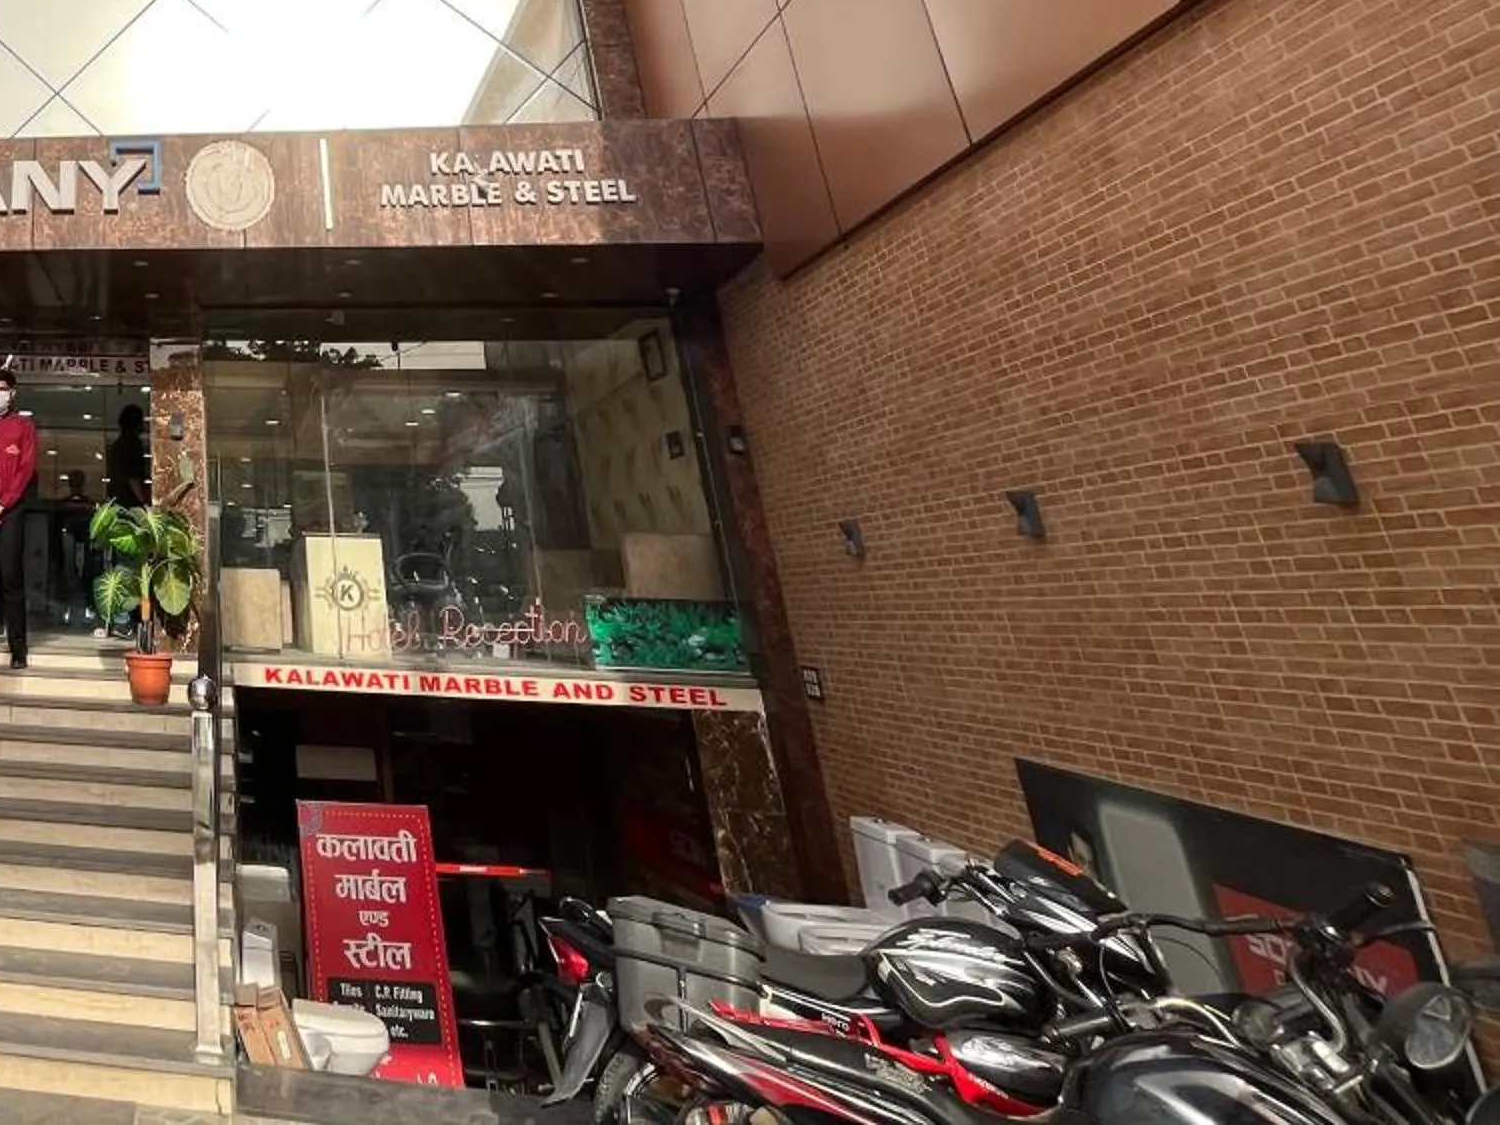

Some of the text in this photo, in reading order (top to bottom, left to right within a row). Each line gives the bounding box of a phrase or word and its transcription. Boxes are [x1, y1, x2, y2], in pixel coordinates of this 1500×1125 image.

[380, 178, 638, 208] MARBLE & STEEL
[265, 667, 728, 707] KALAWATI MARBLE AND STEEL
[315, 829, 417, 863] कलावती
[334, 868, 407, 903] मार्बल
[343, 932, 412, 969] स्टील
